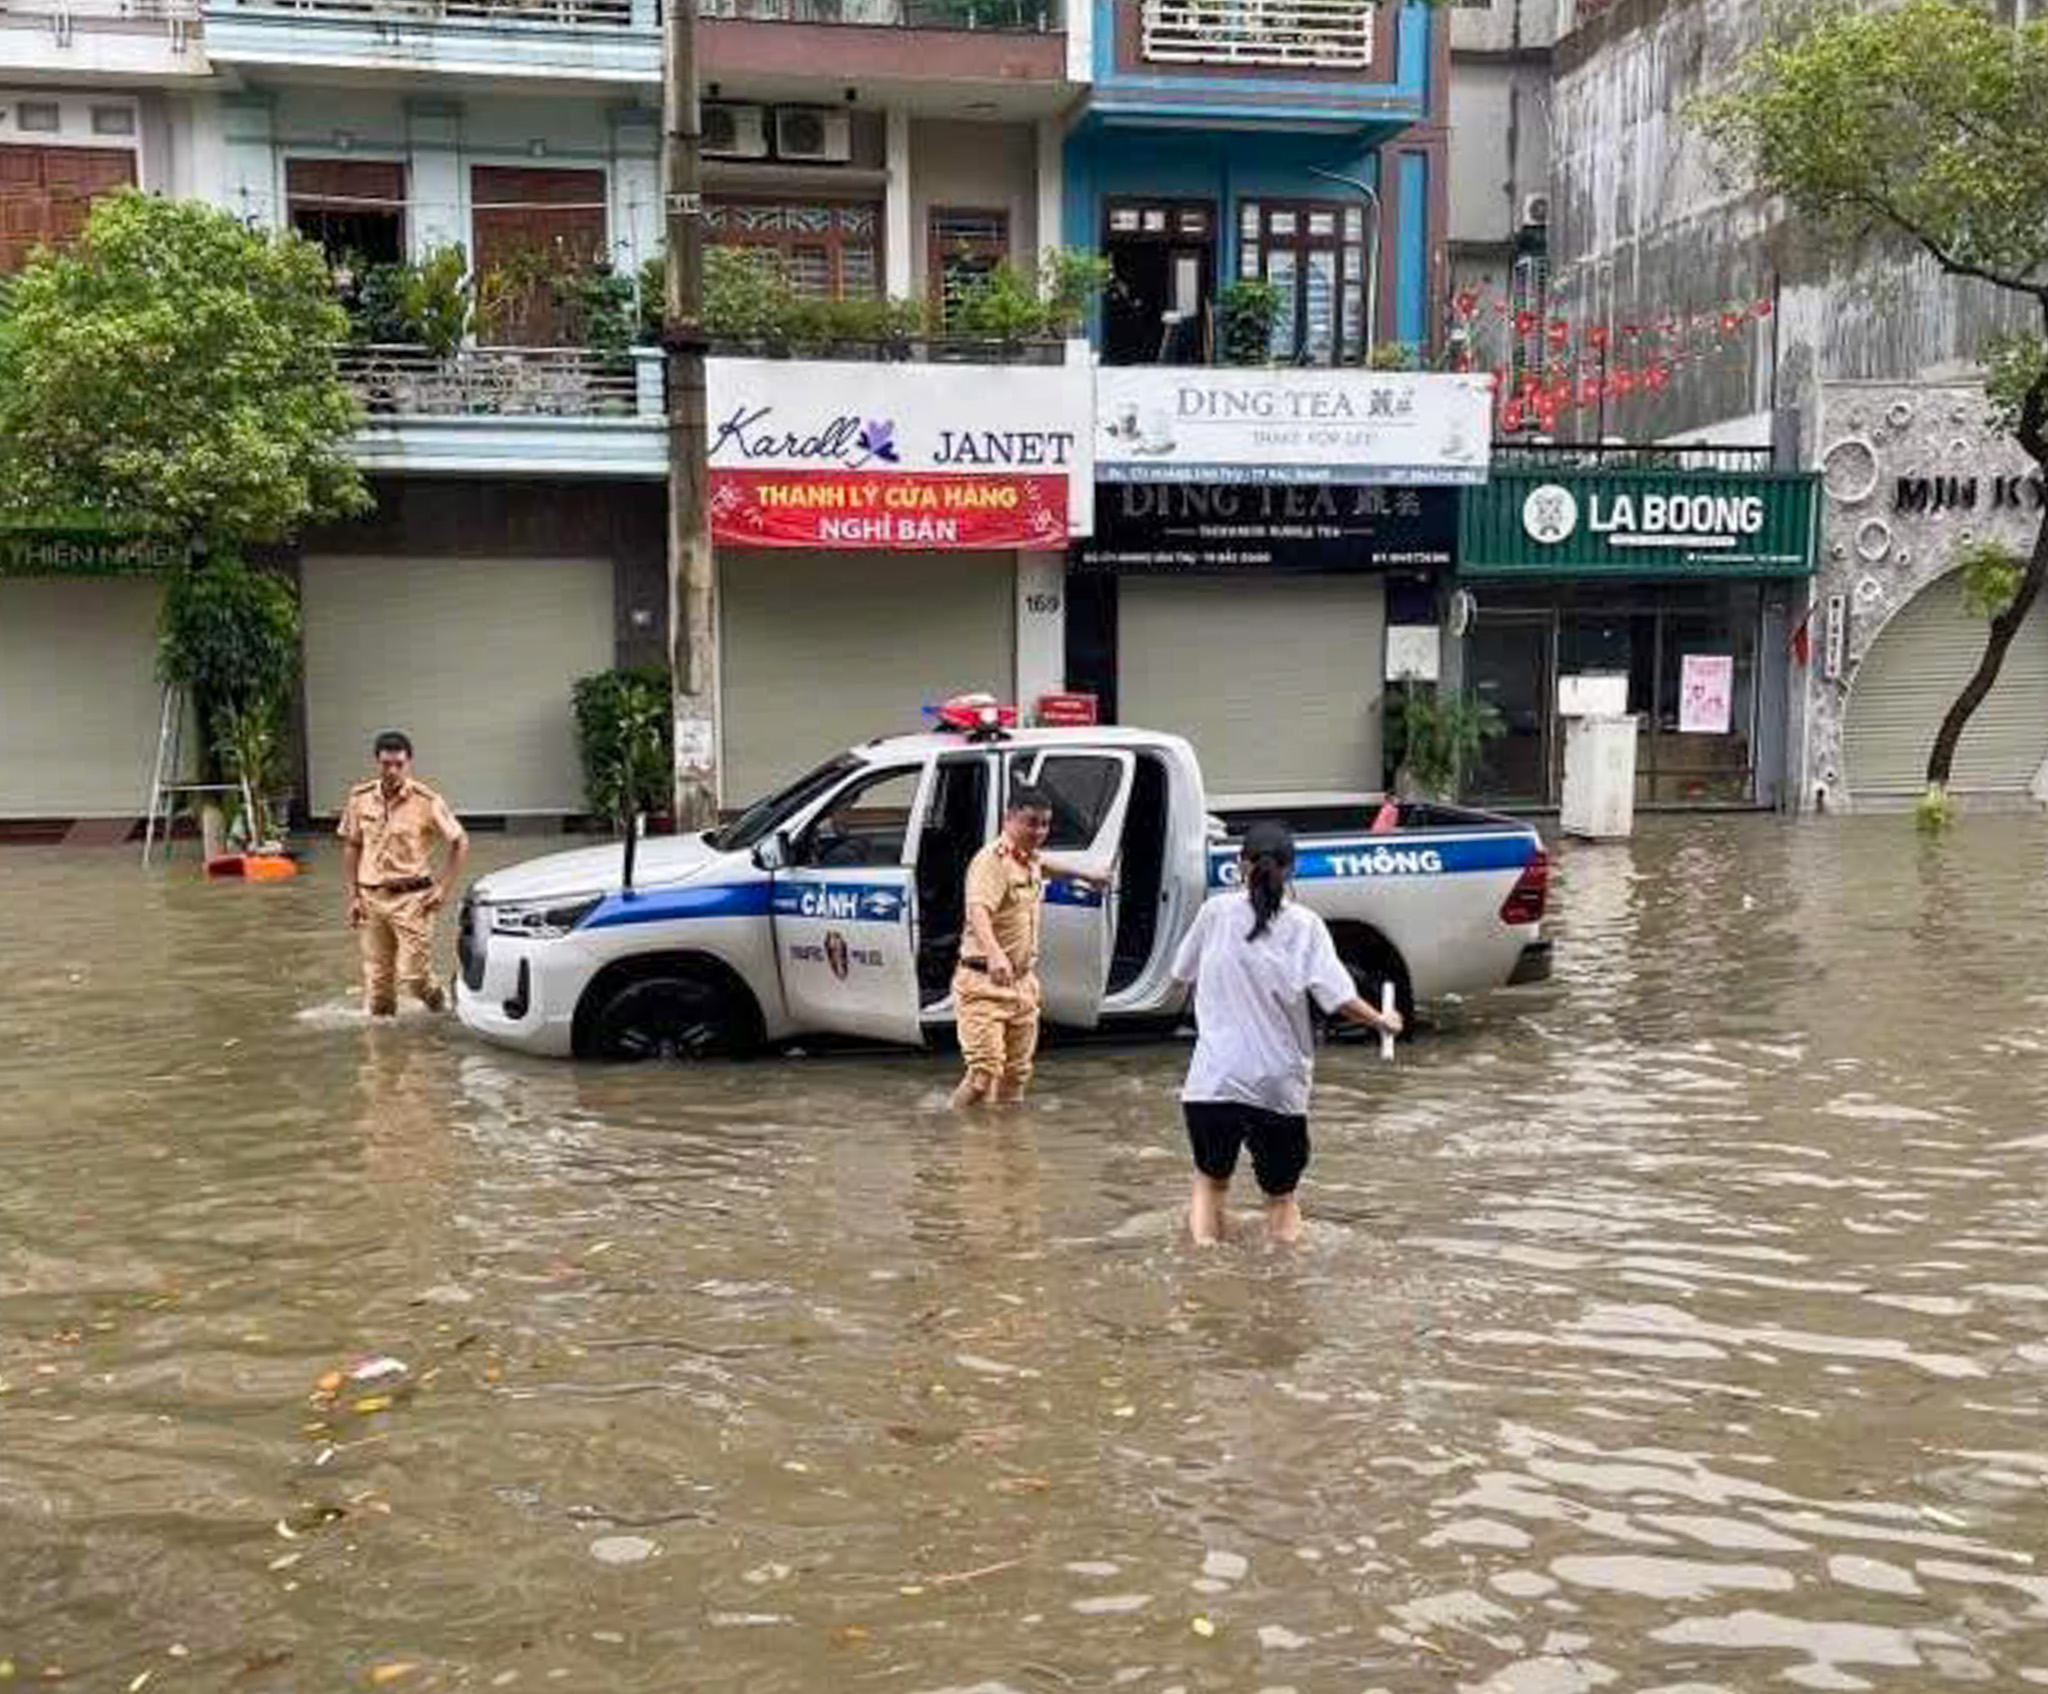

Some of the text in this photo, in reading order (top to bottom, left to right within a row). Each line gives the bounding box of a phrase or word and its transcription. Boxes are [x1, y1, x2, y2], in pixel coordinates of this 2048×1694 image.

[1176, 388, 1274, 417] DING
[1284, 391, 1355, 418] TEA
[933, 431, 1074, 466] JANET
[756, 486, 845, 509] THANH
[884, 477, 938, 509] CỬA
[820, 511, 891, 541] NGHỈ
[1589, 493, 1764, 533] LA BOONG
[1326, 846, 1442, 876] THÔNG
[800, 883, 858, 919] CẢNH
